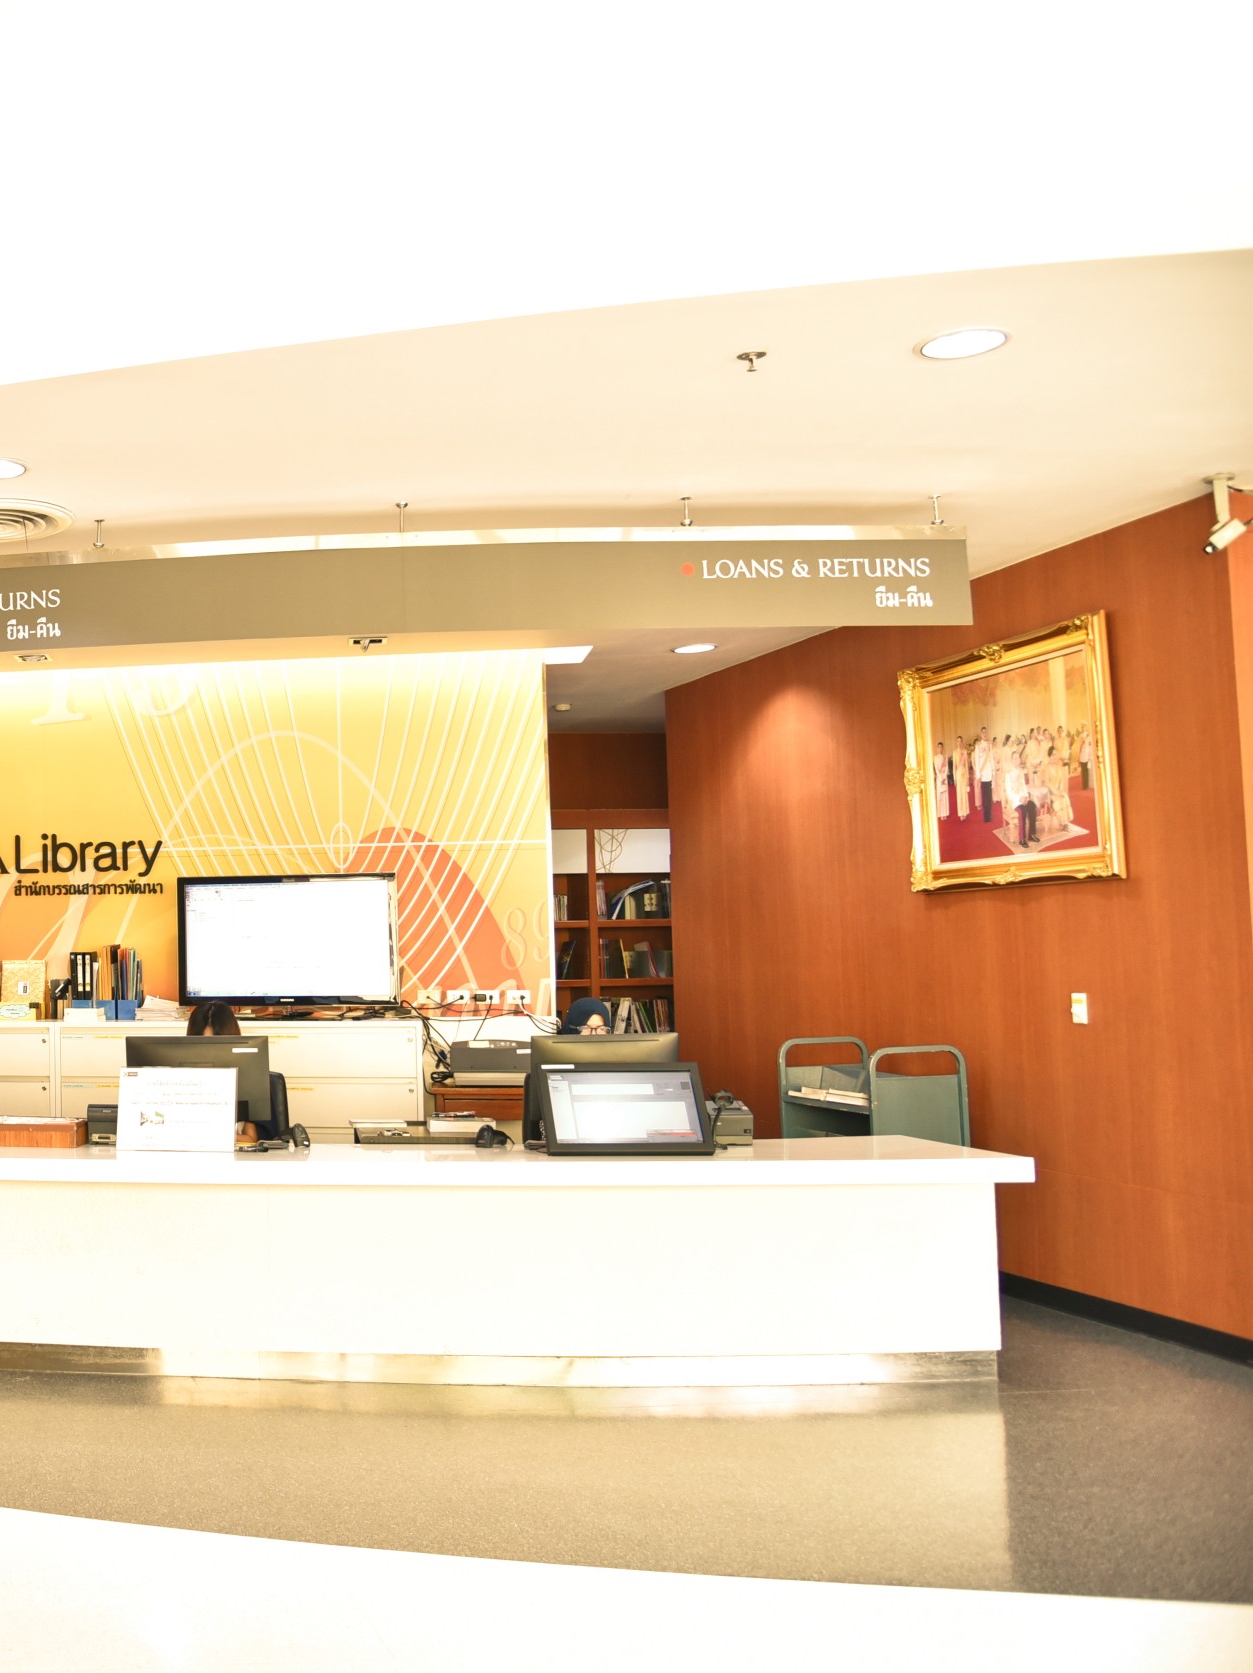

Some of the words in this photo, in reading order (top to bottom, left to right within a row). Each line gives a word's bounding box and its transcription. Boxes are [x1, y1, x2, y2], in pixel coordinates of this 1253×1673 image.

[701, 558, 784, 579] LOANS
[791, 558, 811, 579] &
[818, 557, 931, 578] RETURNS
[875, 585, 934, 608] ยืม-คืน
[6, 616, 61, 640] ยืม-คืน
[14, 833, 163, 877] Library
[14, 879, 163, 897] สำนักบรรณสารการพัฒนา
